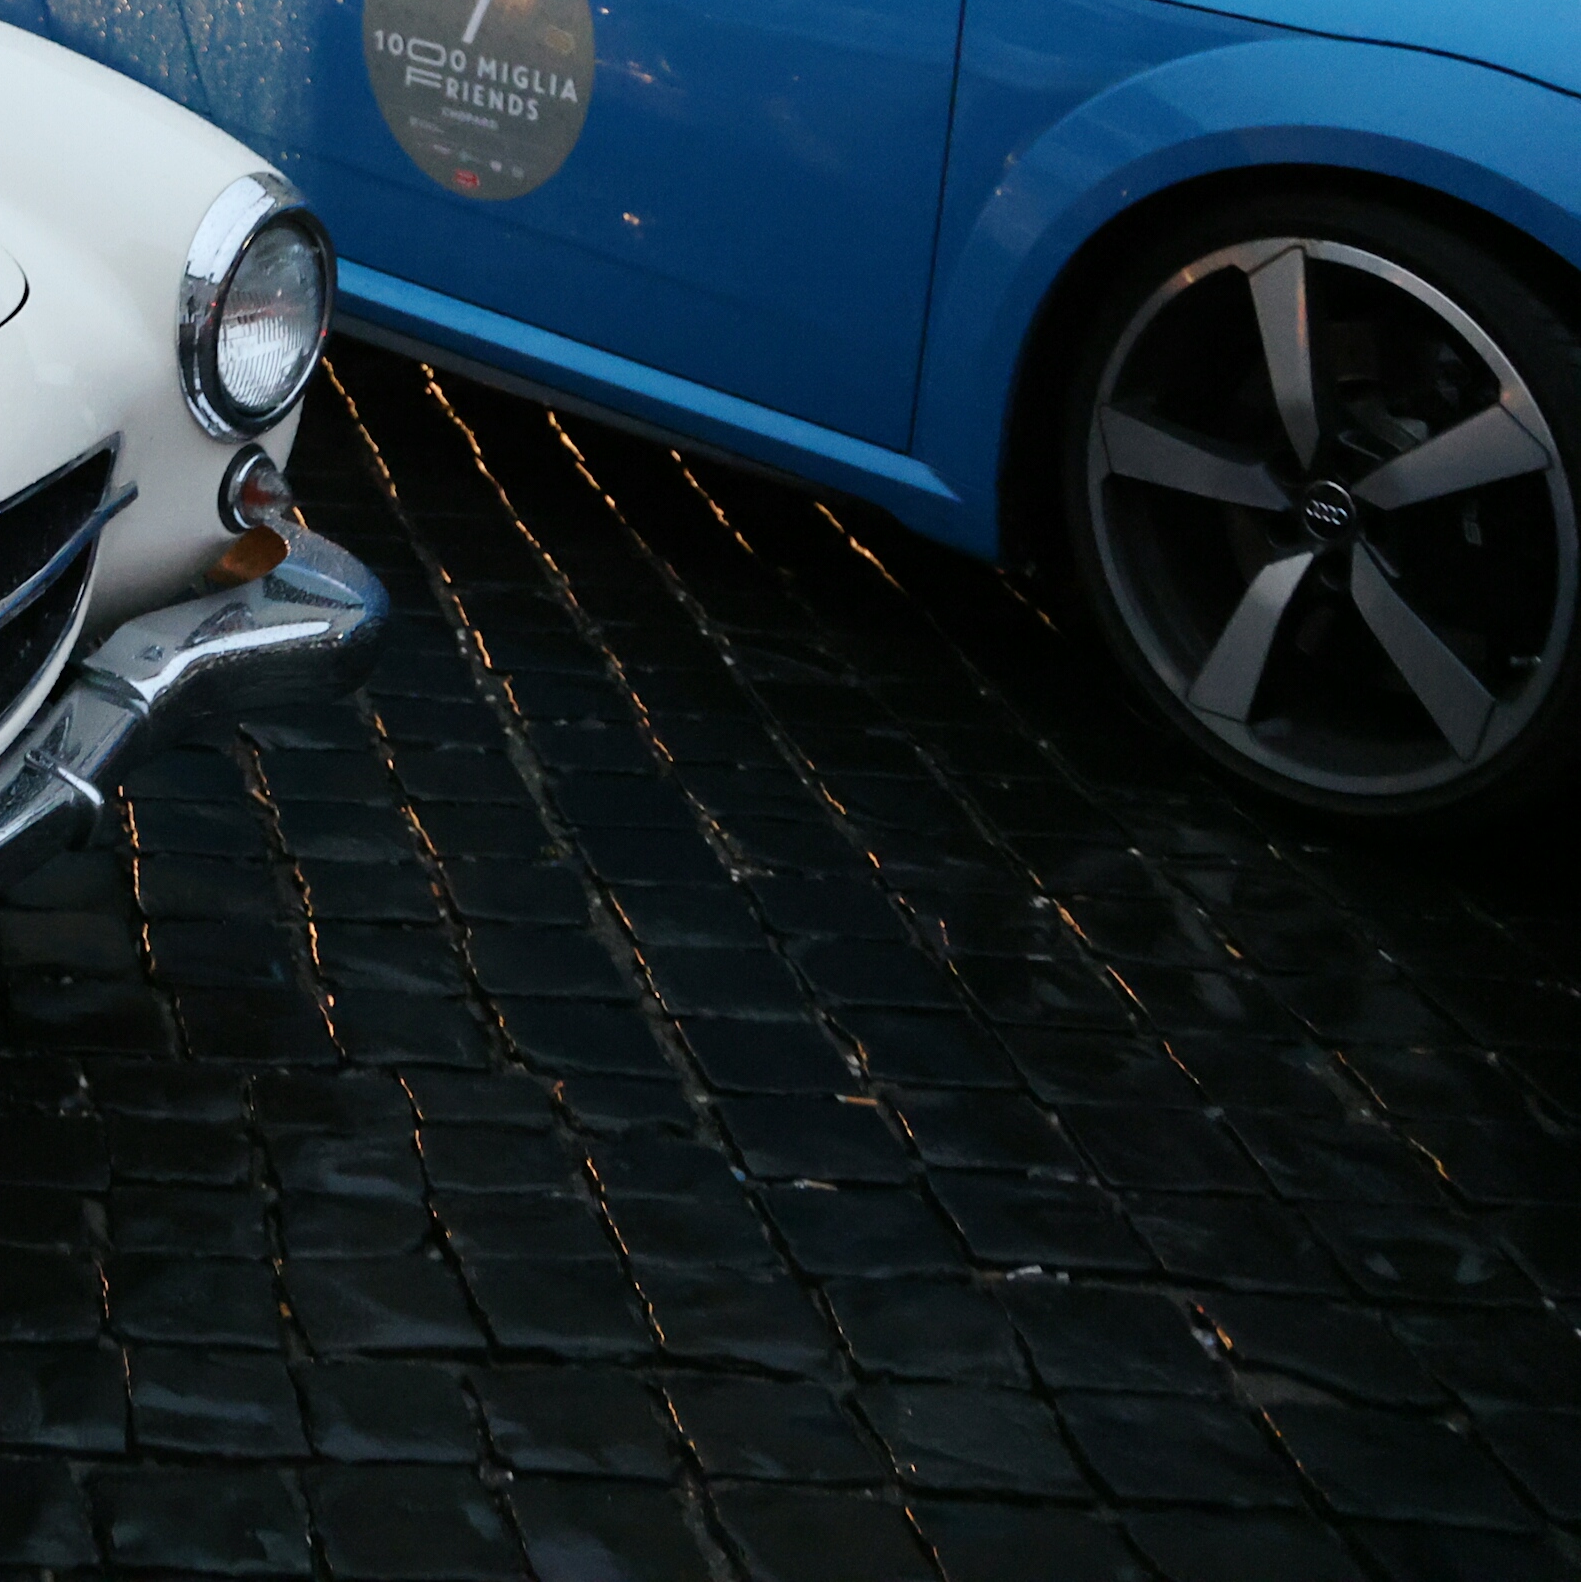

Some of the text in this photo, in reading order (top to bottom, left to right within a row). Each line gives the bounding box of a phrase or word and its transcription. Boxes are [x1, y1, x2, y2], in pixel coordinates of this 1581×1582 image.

[373, 29, 579, 104] 1000 MIGLIA
[404, 64, 539, 121] FRIENDS
